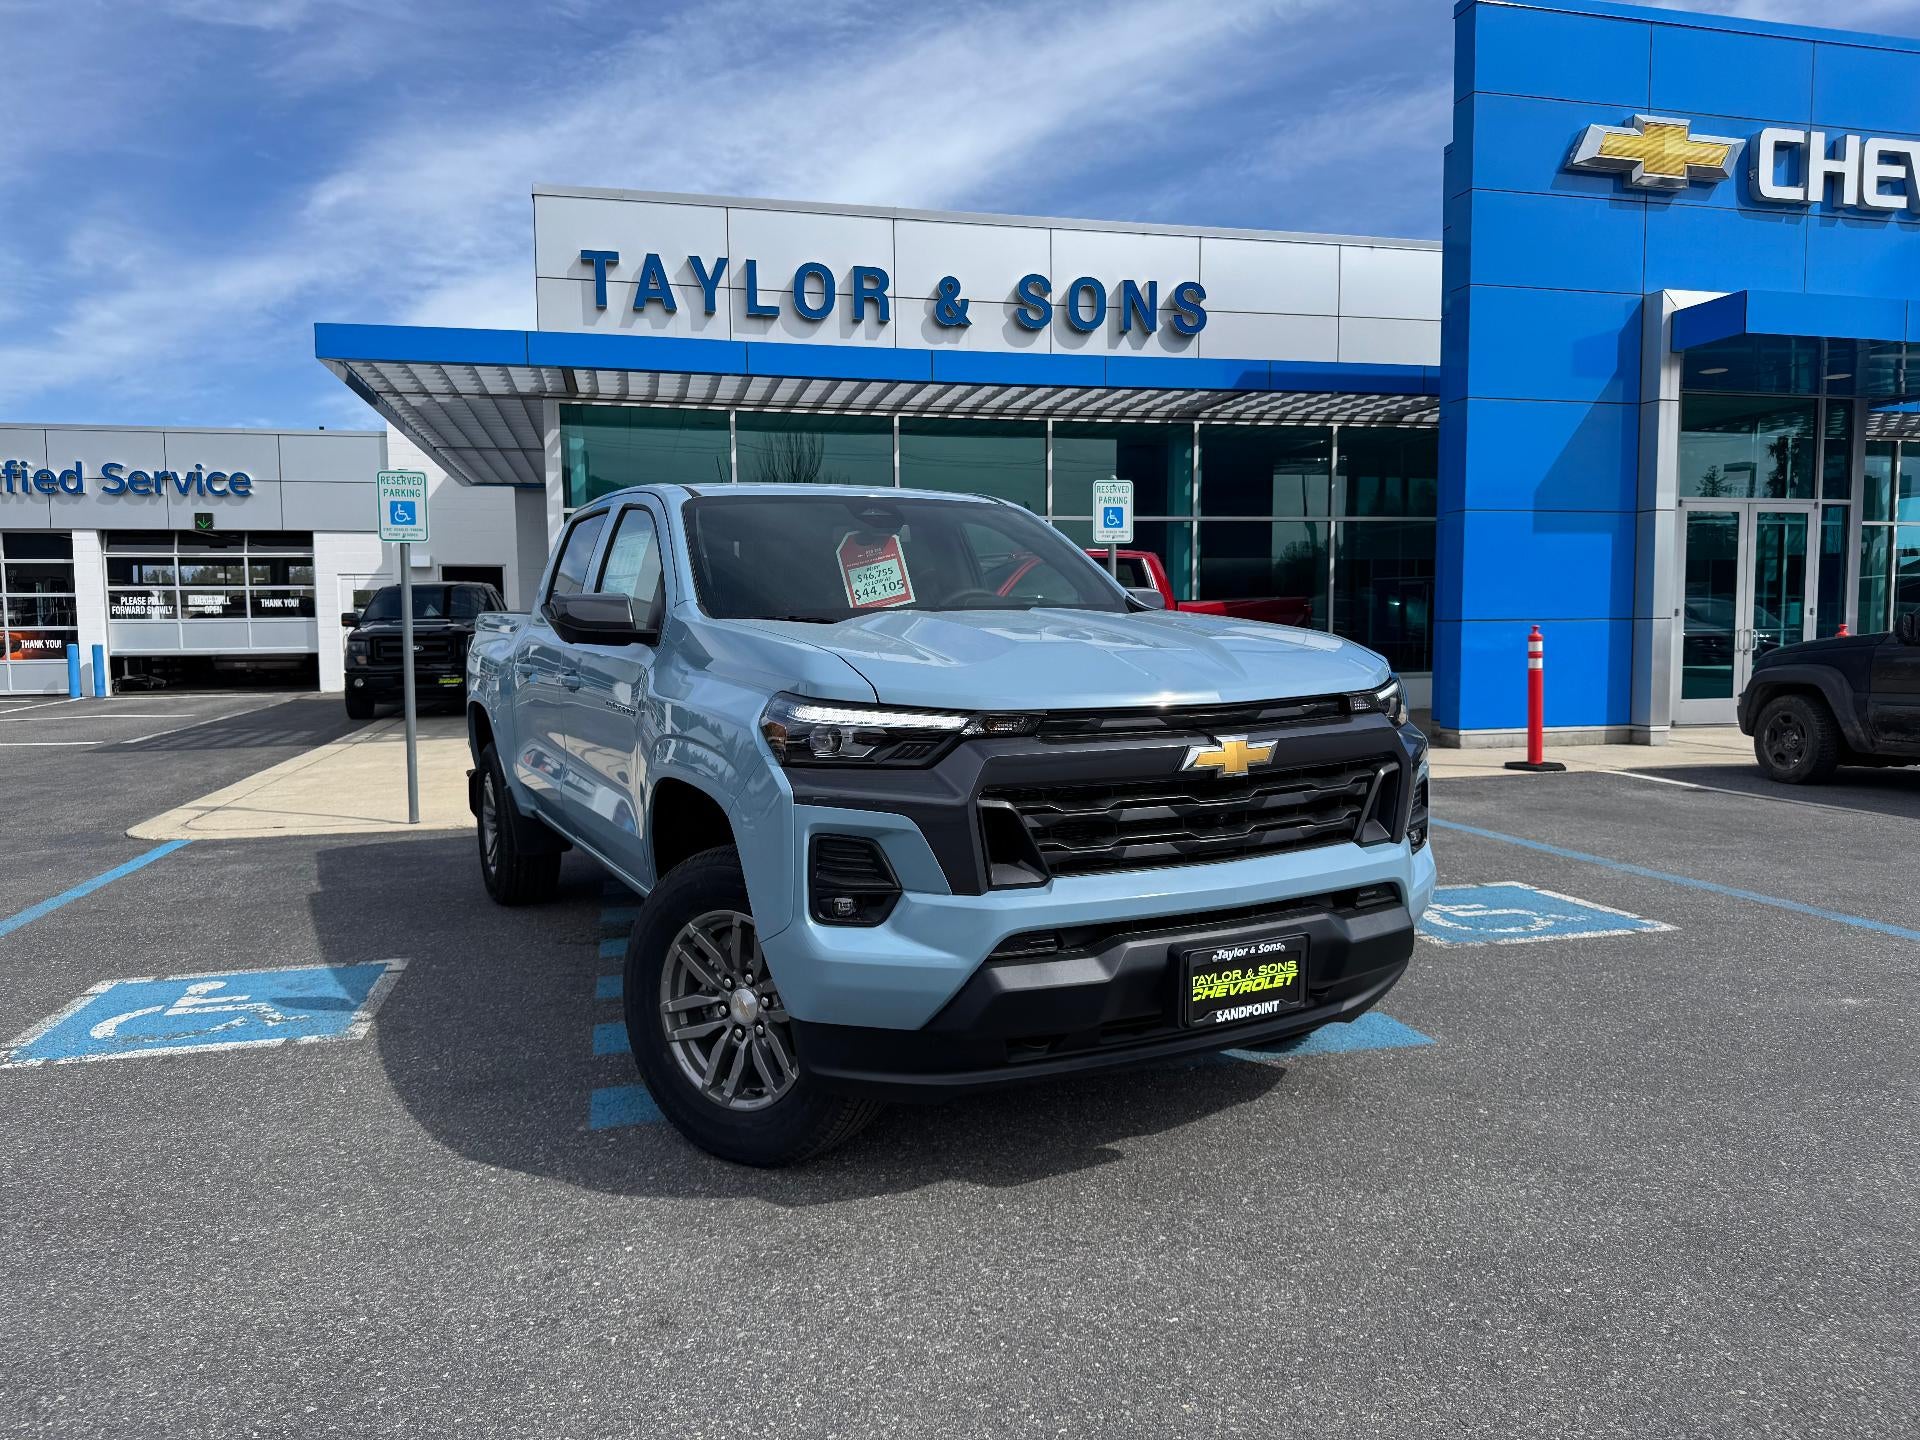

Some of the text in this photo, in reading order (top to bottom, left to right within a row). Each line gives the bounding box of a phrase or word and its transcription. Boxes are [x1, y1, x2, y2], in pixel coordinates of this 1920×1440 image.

[1757, 127, 1920, 210] CHE
[579, 249, 1208, 336] TAYLOR & SONS
[101, 462, 252, 496] Service
[380, 476, 423, 486] RESERVED
[383, 488, 421, 498] PARKING
[1096, 485, 1130, 494] RESERVED
[1098, 496, 1128, 505] PARKING
[857, 567, 894, 583] $46,755
[854, 579, 905, 600] $44,105
[120, 596, 147, 606] PLEASE
[260, 598, 300, 608] THANK YOU!
[111, 606, 174, 615] FORWARD SLOWLY
[204, 605, 223, 614] OPEN
[20, 639, 62, 649] THANK YOU!
[1216, 942, 1282, 961] Taylor & Sons
[1192, 960, 1297, 987] TAYLOR & SONS
[1192, 972, 1298, 1001] CHEVROLET
[1215, 1000, 1280, 1023] SANDPOINT
